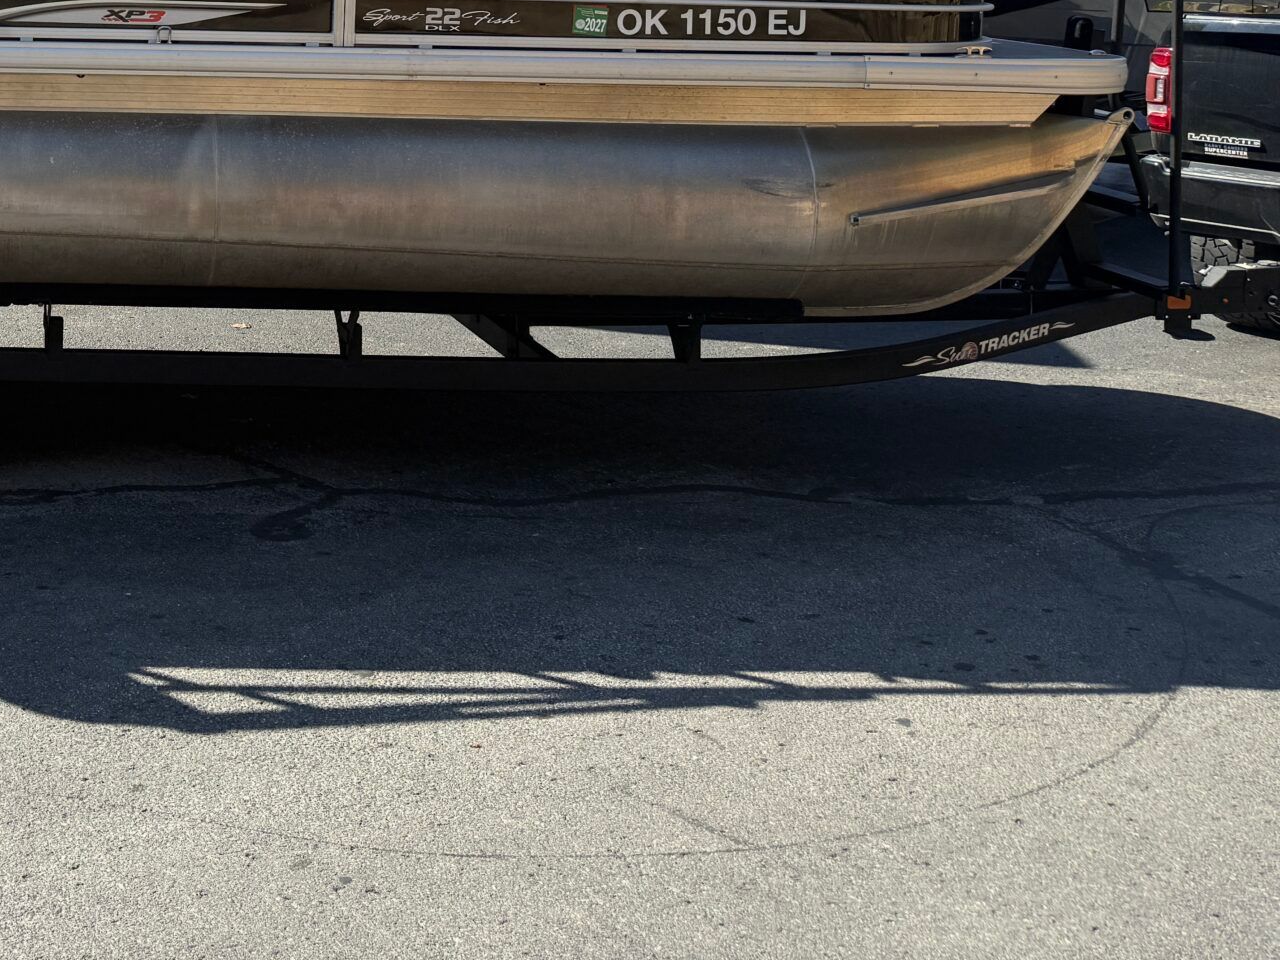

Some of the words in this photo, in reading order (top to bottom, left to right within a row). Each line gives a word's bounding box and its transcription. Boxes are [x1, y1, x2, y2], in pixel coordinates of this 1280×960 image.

[102, 9, 166, 22] XP3
[363, 8, 424, 26] Sport
[426, 7, 461, 25] 22
[462, 10, 520, 26] Fish
[617, 8, 669, 35] OK
[680, 8, 756, 35] 1150
[768, 9, 807, 35] EJ
[584, 17, 607, 32] 2027
[1187, 132, 1261, 147] LARAMIE
[1204, 147, 1248, 156] SUPERCENTER
[979, 322, 1050, 354] TRACKER
